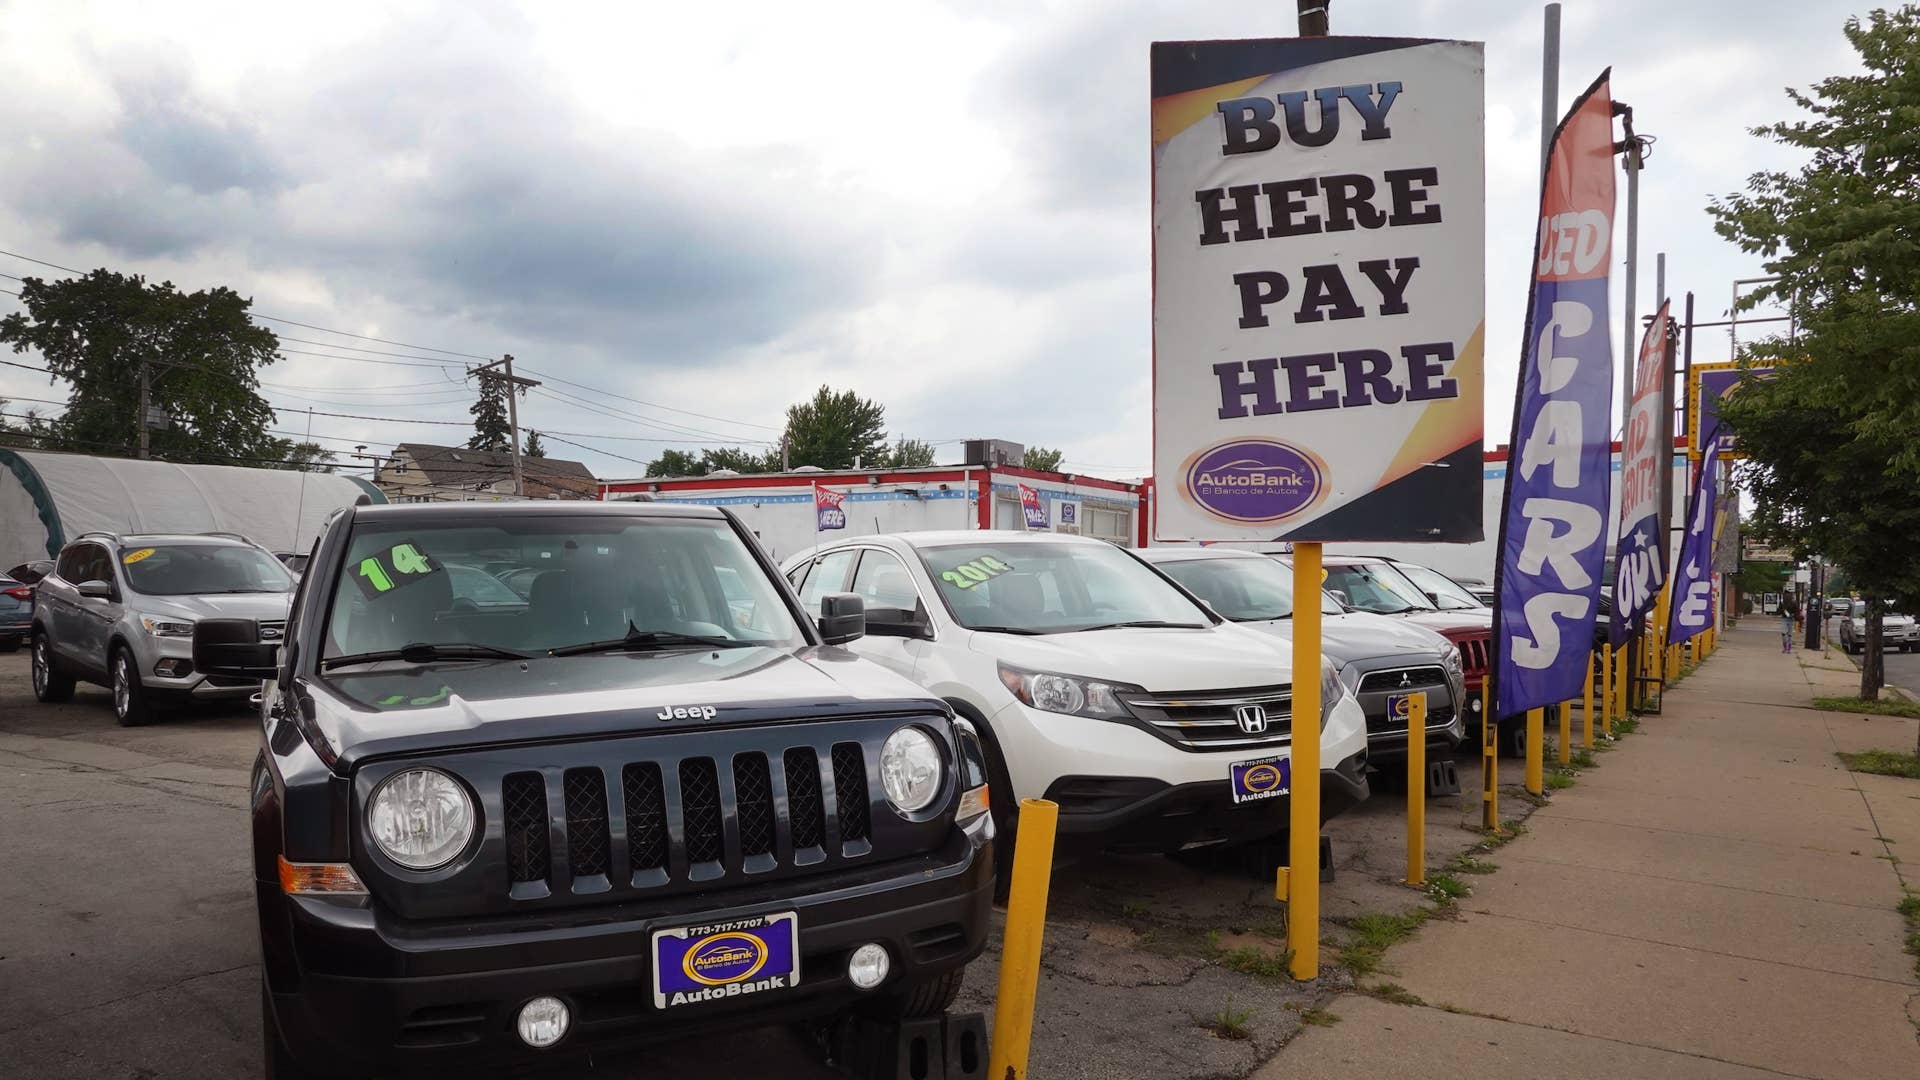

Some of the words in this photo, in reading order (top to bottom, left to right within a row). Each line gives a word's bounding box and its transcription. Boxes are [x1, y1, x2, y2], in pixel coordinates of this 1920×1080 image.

[1217, 81, 1403, 156] BUY
[1195, 167, 1442, 246] HERE
[1233, 256, 1420, 329] PAY
[1212, 341, 1459, 420] HERE
[1197, 473, 1304, 486] AutoBank
[1202, 487, 1212, 495] El
[1214, 487, 1248, 495] Banco
[1250, 487, 1264, 495] de
[1266, 487, 1298, 495] Autos
[1511, 300, 1602, 669] CARS
[359, 543, 432, 592] 14
[942, 556, 1009, 588] 2014
[1618, 544, 1662, 618] OK!
[657, 705, 717, 721] Jeep
[1240, 787, 1289, 802] AutoBank
[689, 917, 763, 936] 773-717-7707
[694, 950, 753, 967] AutoBank
[670, 976, 785, 1007] AutoBank
